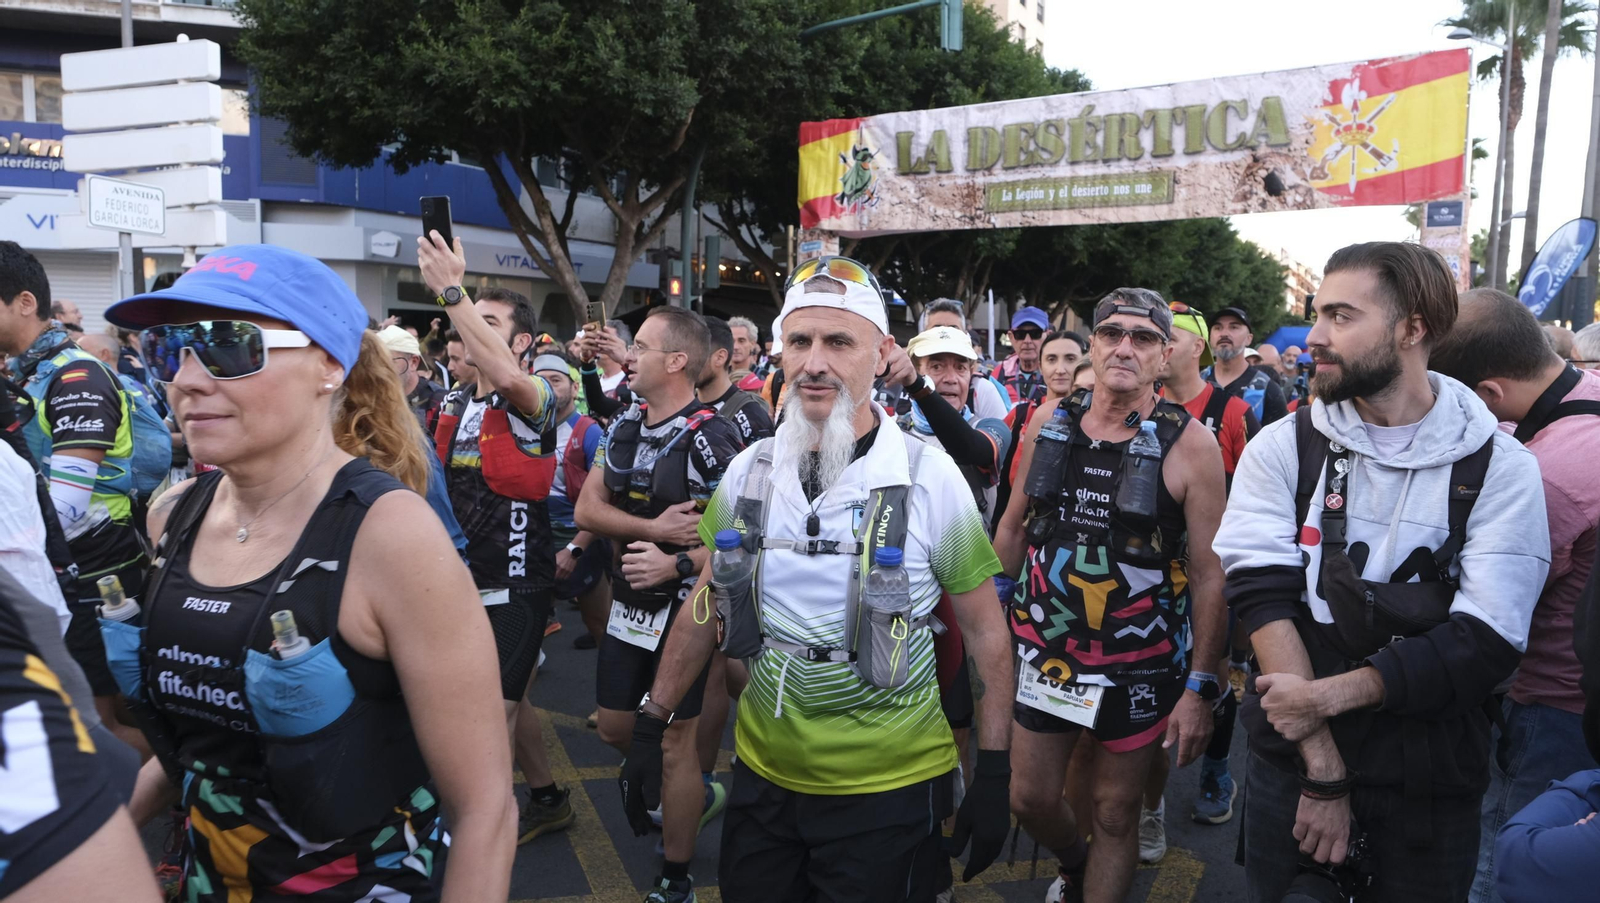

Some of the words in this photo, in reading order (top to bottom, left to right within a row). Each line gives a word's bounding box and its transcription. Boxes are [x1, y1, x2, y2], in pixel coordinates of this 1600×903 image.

[896, 130, 953, 175] LA
[966, 96, 1292, 171] DESÉRTICA
[0, 157, 64, 172] terdiscipl
[112, 187, 160, 201] AVENIDA
[1002, 189, 1012, 201] La
[1016, 187, 1044, 201] Legión
[1049, 188, 1055, 200] y
[1059, 185, 1068, 197] el
[1072, 183, 1109, 197] desierto
[1113, 185, 1130, 195] nos
[1135, 183, 1152, 194] une
[105, 197, 149, 215] FEDERICO
[131, 215, 160, 230] LORCA
[495, 253, 583, 276] VITALT
[53, 415, 104, 434] Salas
[1084, 466, 1113, 478] FASTER
[1076, 487, 1110, 503] alma
[876, 504, 893, 549] AONIJI
[1071, 516, 1110, 529] RUNNING
[182, 596, 231, 614] FASTER
[157, 644, 222, 668] alma
